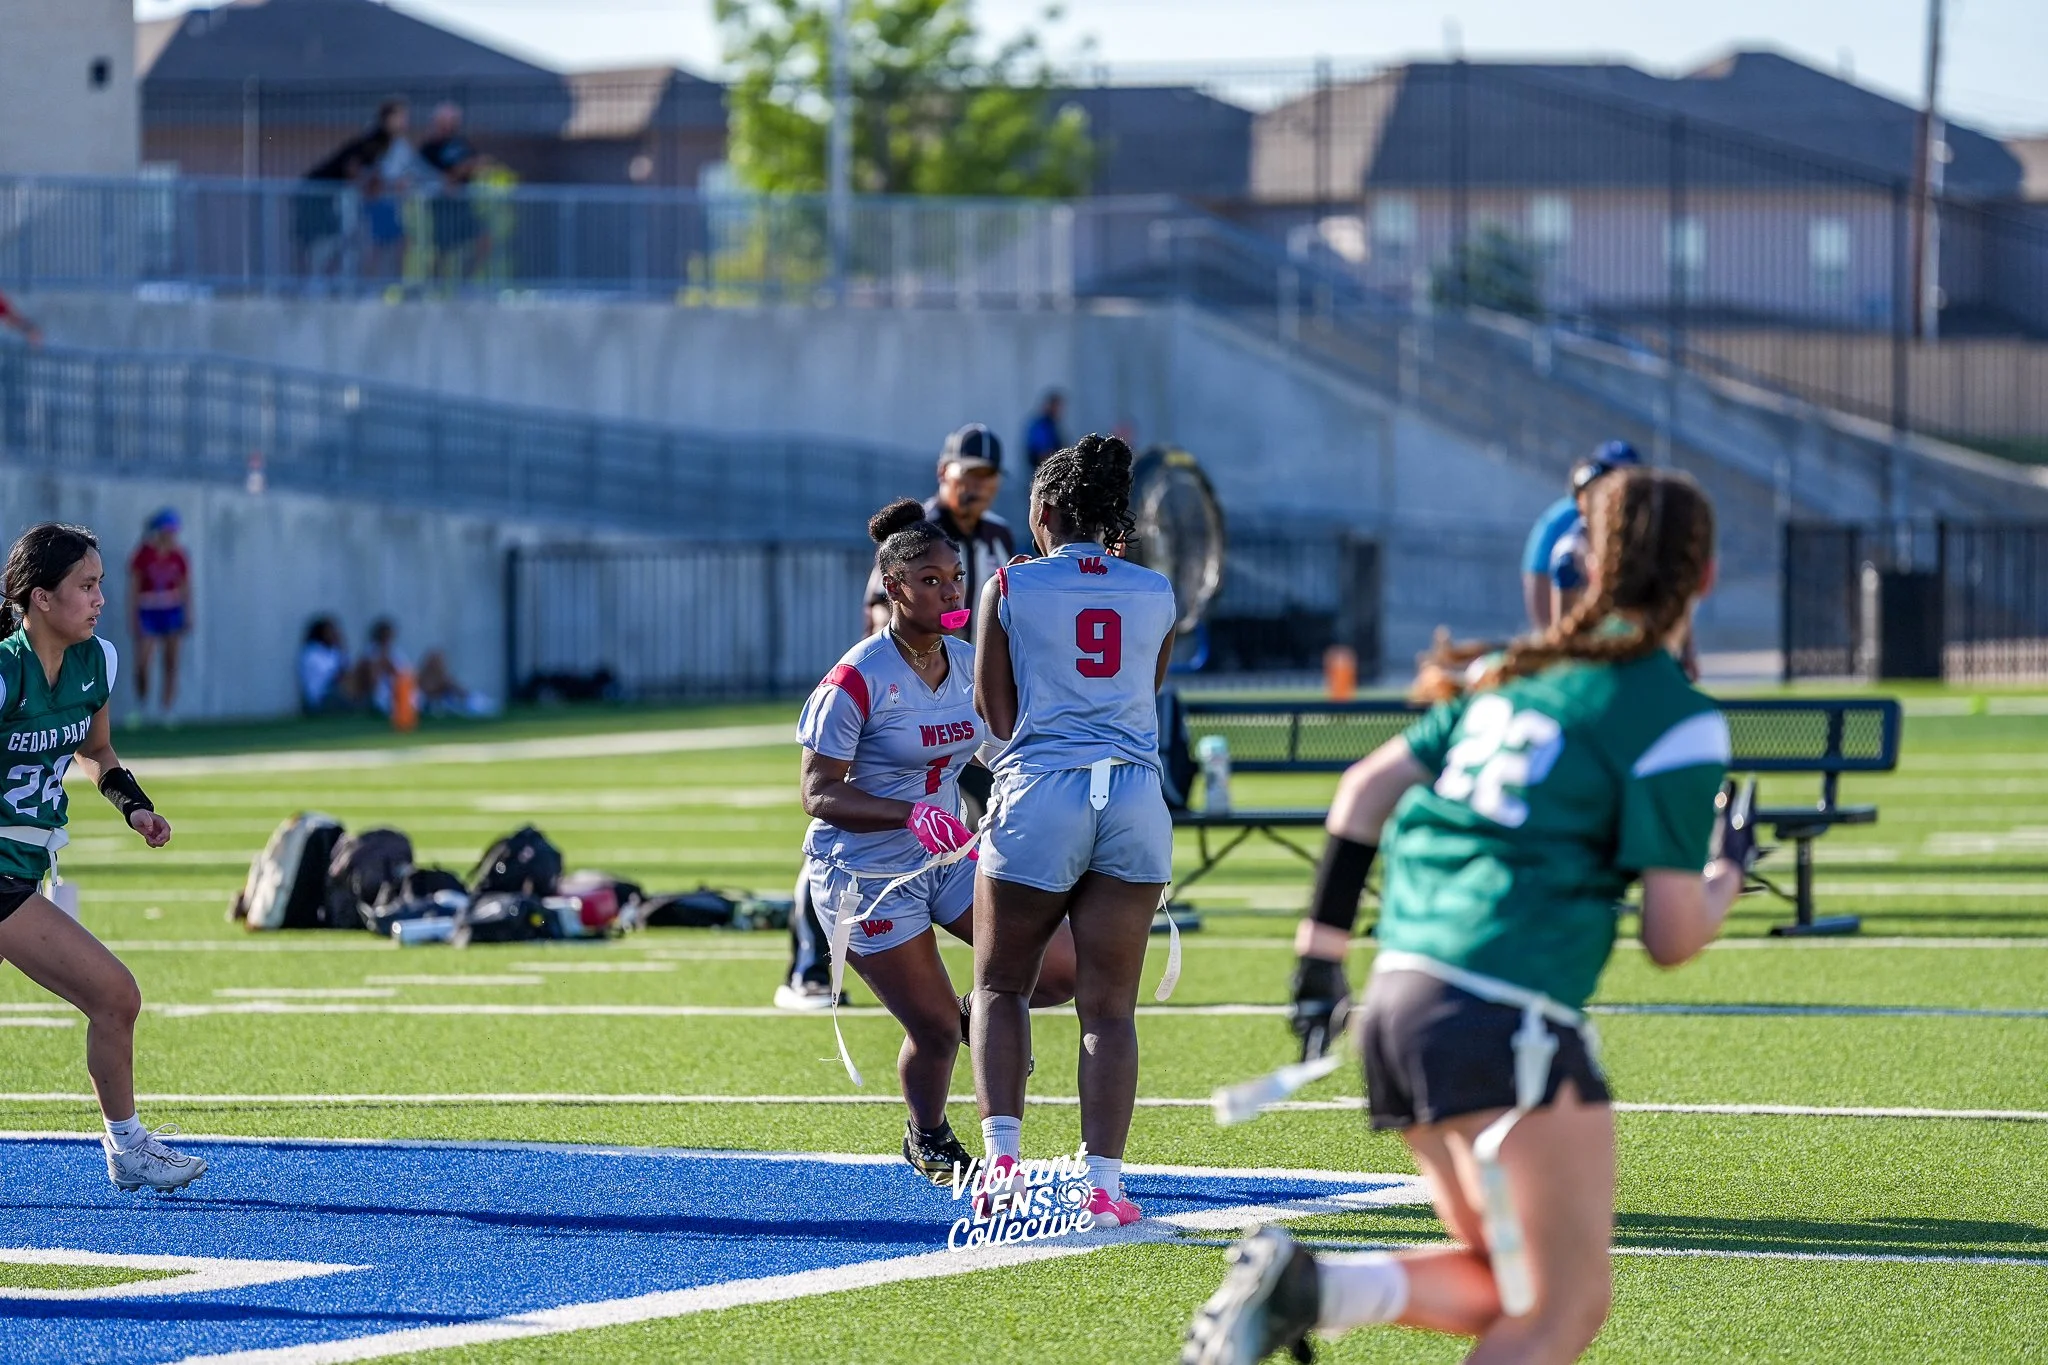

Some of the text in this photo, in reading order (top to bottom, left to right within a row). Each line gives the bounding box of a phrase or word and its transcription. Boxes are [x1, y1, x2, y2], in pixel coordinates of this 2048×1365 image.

[1075, 607, 1122, 678] 9
[7, 728, 58, 753] CEDAR
[918, 720, 975, 747] WEISS
[1433, 693, 1566, 829] 22
[3, 753, 75, 818] 24
